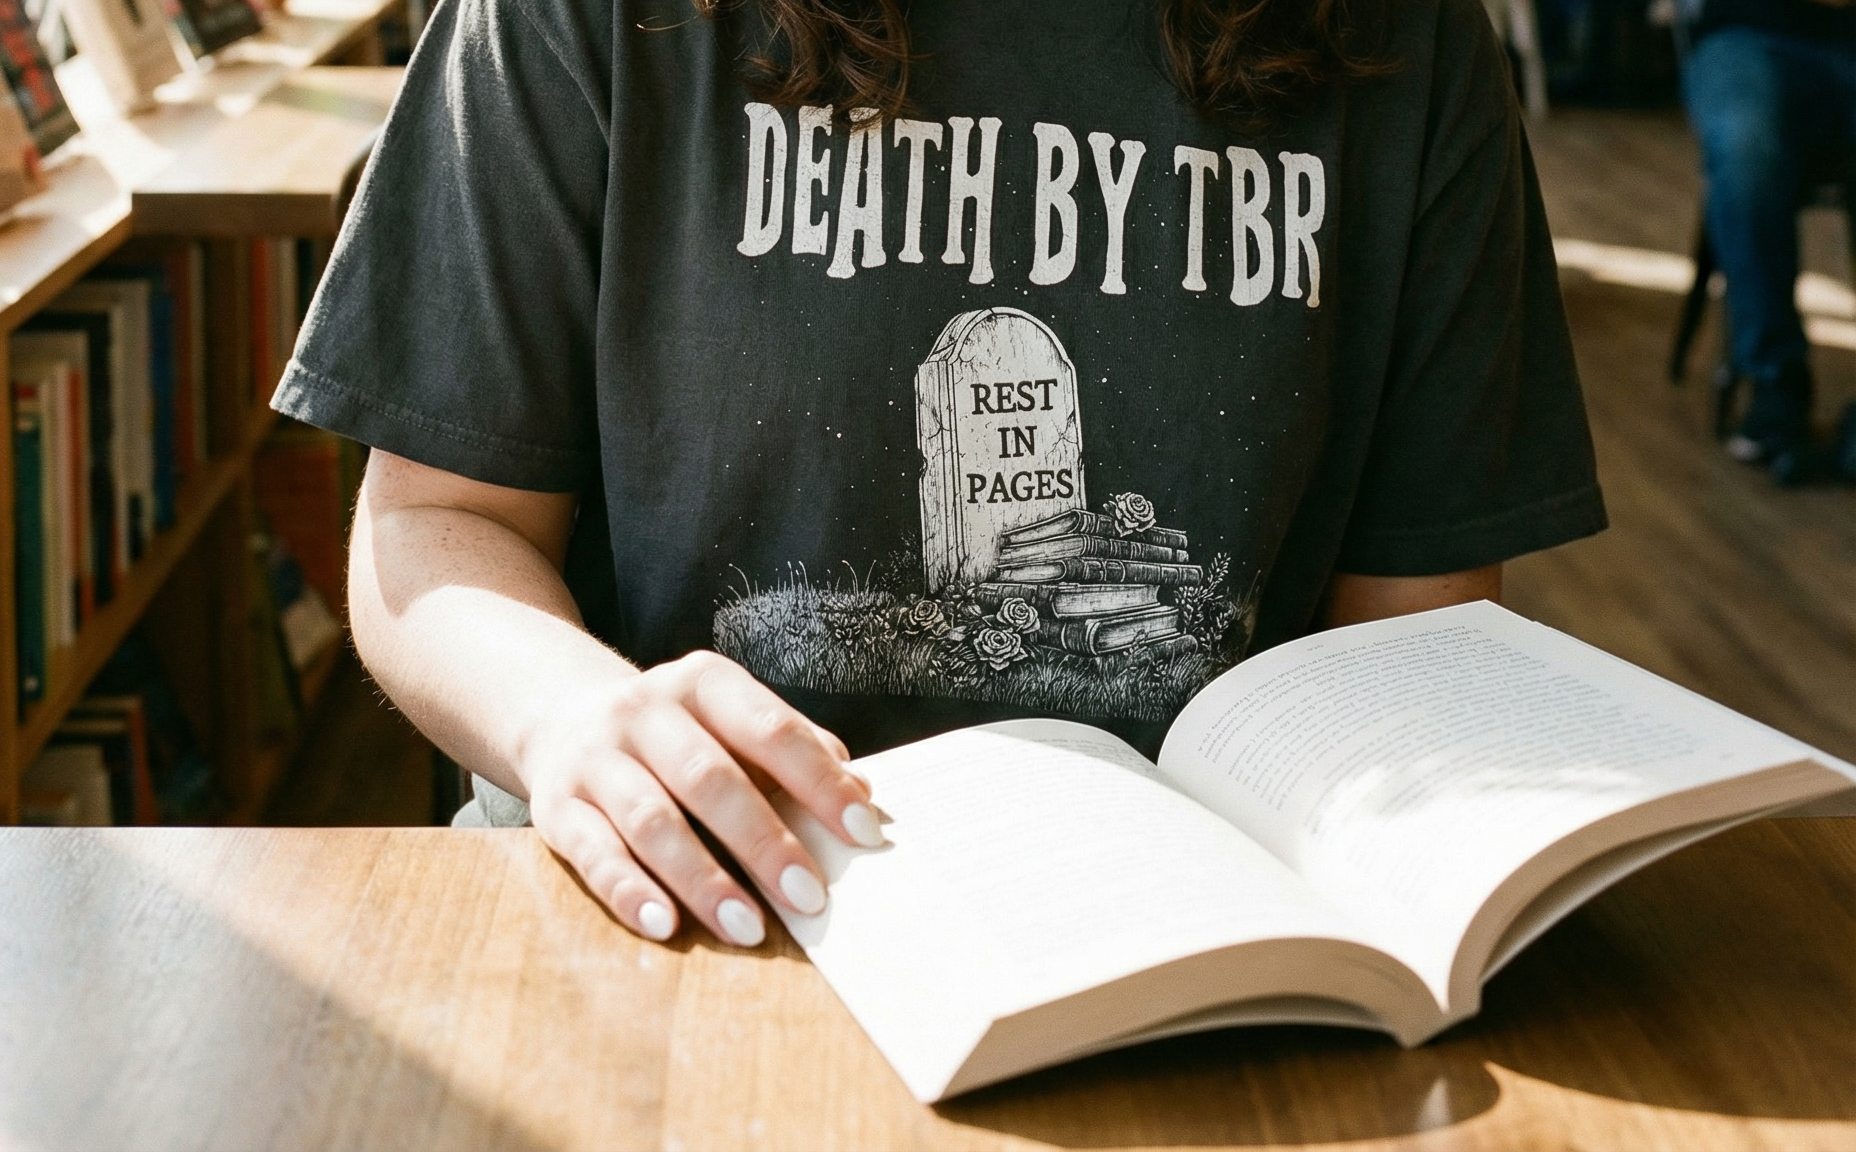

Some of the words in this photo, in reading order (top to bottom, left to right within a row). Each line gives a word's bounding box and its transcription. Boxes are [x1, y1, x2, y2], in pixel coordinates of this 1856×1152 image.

[736, 102, 1002, 285] DEATH
[1028, 122, 1146, 294] BY
[1173, 145, 1325, 308] TBR
[970, 378, 1058, 415] REST
[997, 425, 1037, 459] IN
[966, 468, 1074, 504] PAGES
